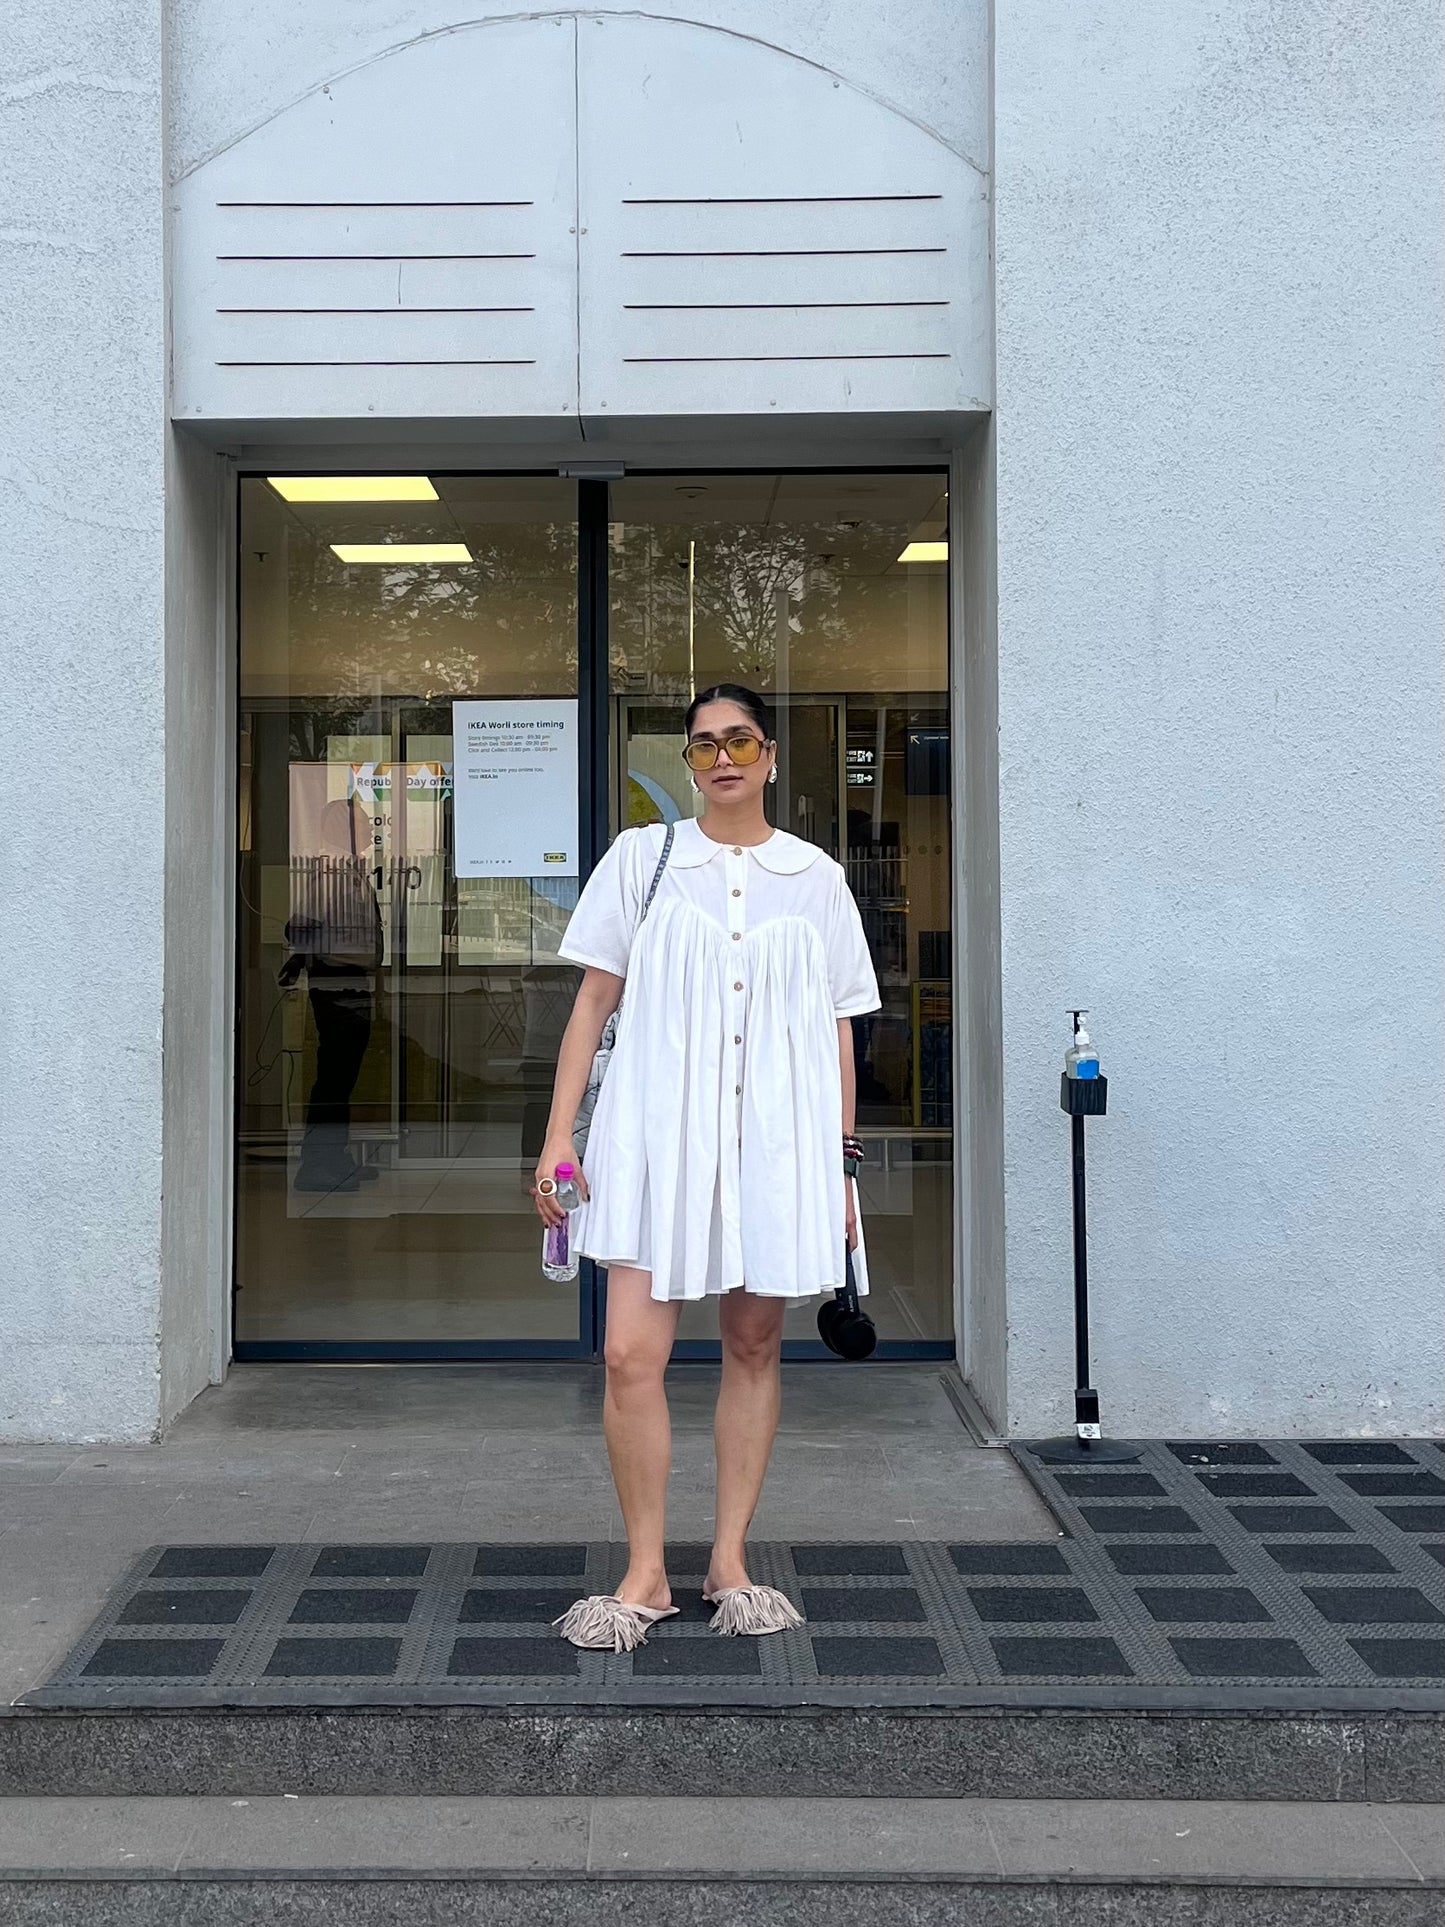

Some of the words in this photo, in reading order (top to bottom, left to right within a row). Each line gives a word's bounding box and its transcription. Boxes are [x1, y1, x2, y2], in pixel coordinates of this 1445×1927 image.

[467, 721, 487, 730] IKEA
[488, 721, 511, 729] Worli
[512, 721, 535, 729] store
[536, 720, 565, 730] timing
[357, 777, 392, 788] Repub
[407, 777, 426, 789] Day
